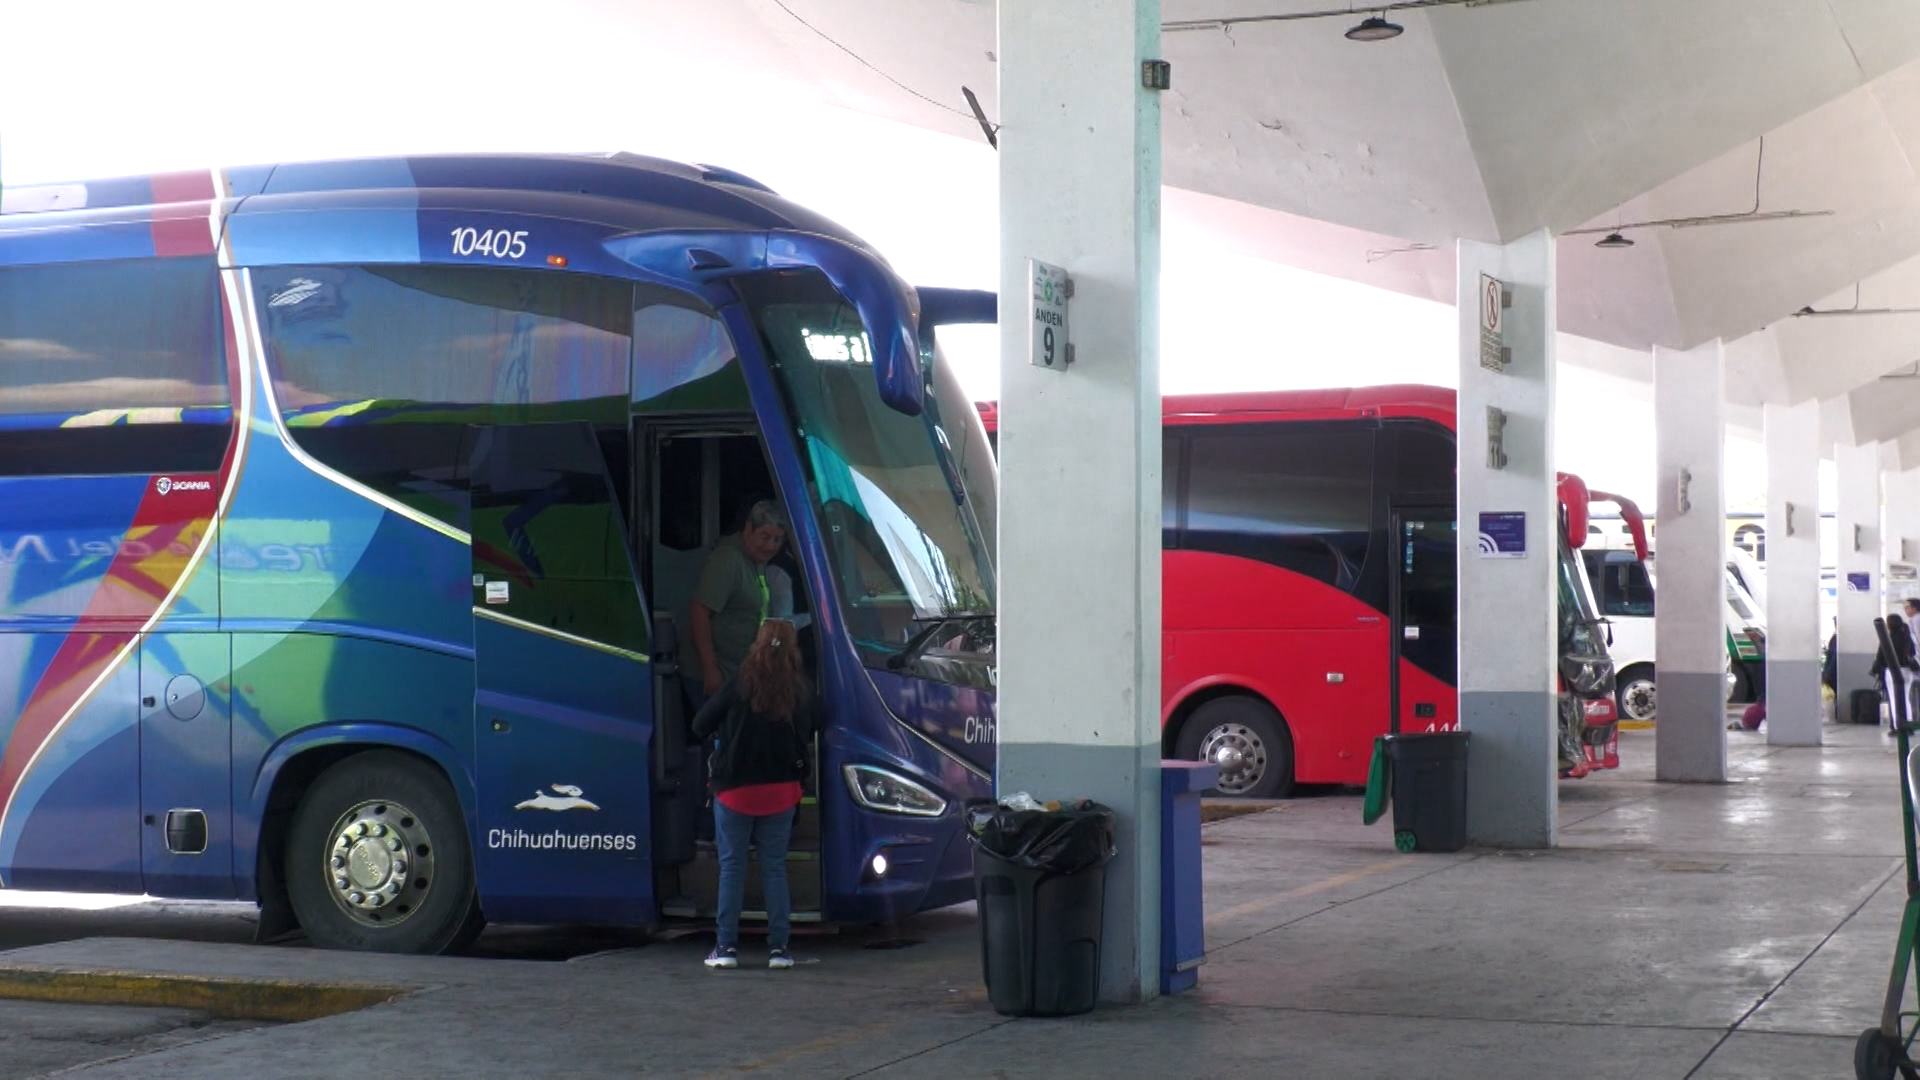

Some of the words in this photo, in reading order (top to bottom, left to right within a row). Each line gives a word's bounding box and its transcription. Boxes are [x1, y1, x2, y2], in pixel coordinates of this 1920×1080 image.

[451, 227, 529, 258] 10405
[1035, 307, 1063, 327] ANDEN
[1043, 326, 1054, 365] 9
[173, 481, 211, 490] SCANIA
[488, 829, 637, 850] Chihuahuenses
